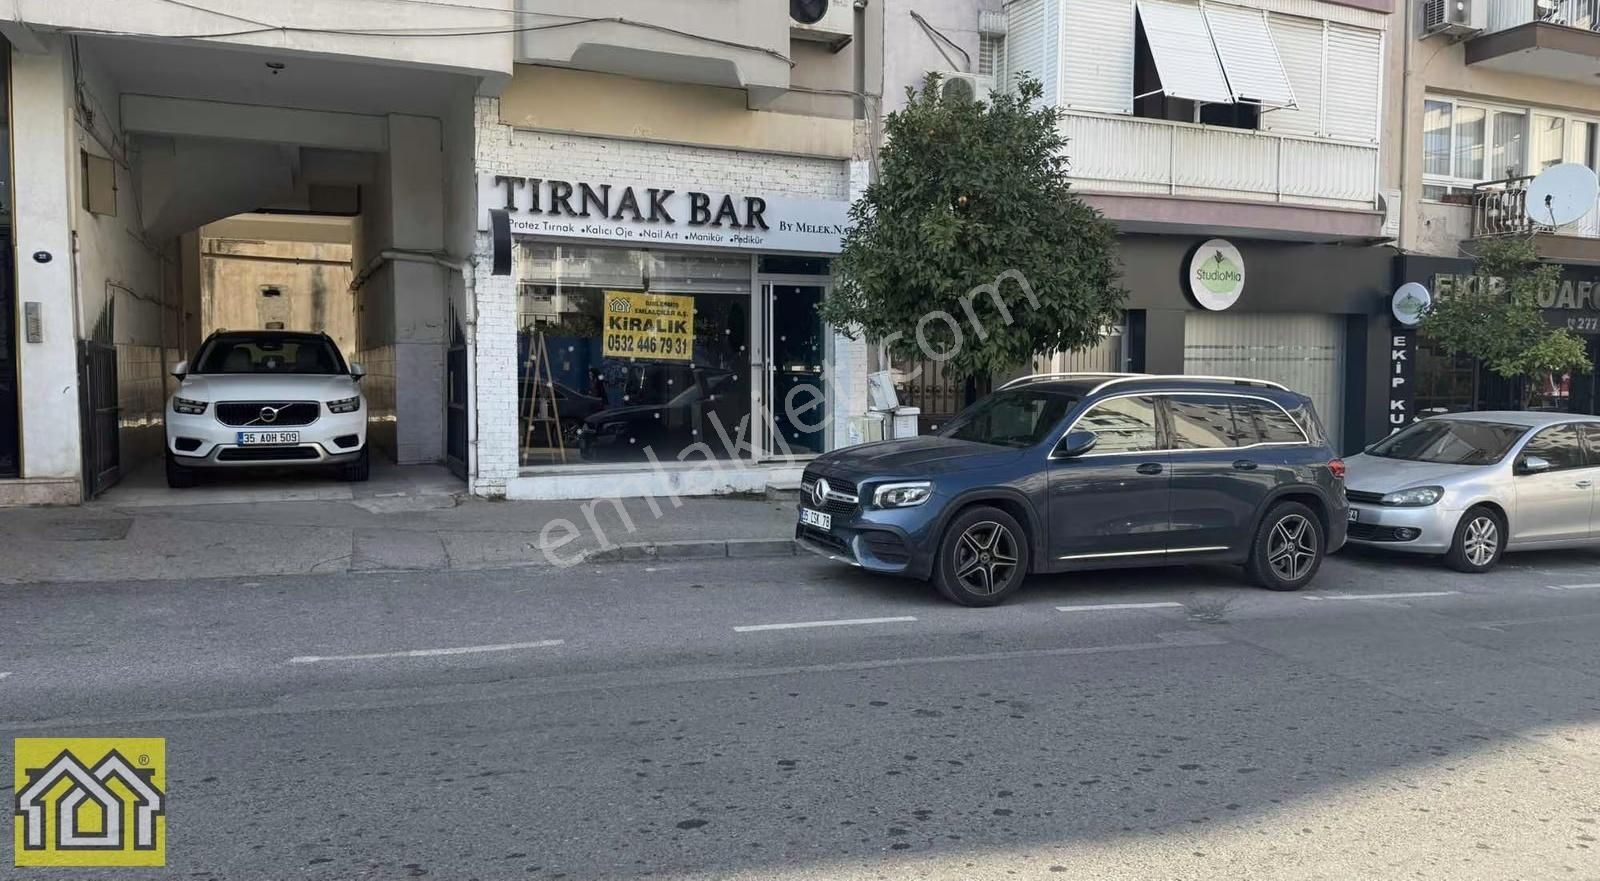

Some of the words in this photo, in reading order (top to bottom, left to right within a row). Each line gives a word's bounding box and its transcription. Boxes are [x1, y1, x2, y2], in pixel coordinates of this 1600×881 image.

[495, 175, 675, 222] TIRNAK
[688, 192, 770, 230] BAR
[615, 227, 633, 238] Oje
[643, 230, 663, 240] Nail
[665, 231, 679, 240] Art
[689, 232, 724, 243] Manikür
[733, 234, 764, 245] Pedikür
[1196, 268, 1242, 282] StudioMia
[608, 334, 634, 351] 0532
[637, 336, 657, 353] 446
[660, 337, 672, 353] 79
[675, 338, 687, 354] 31
[244, 434, 255, 442] 35
[280, 433, 297, 442] 509
